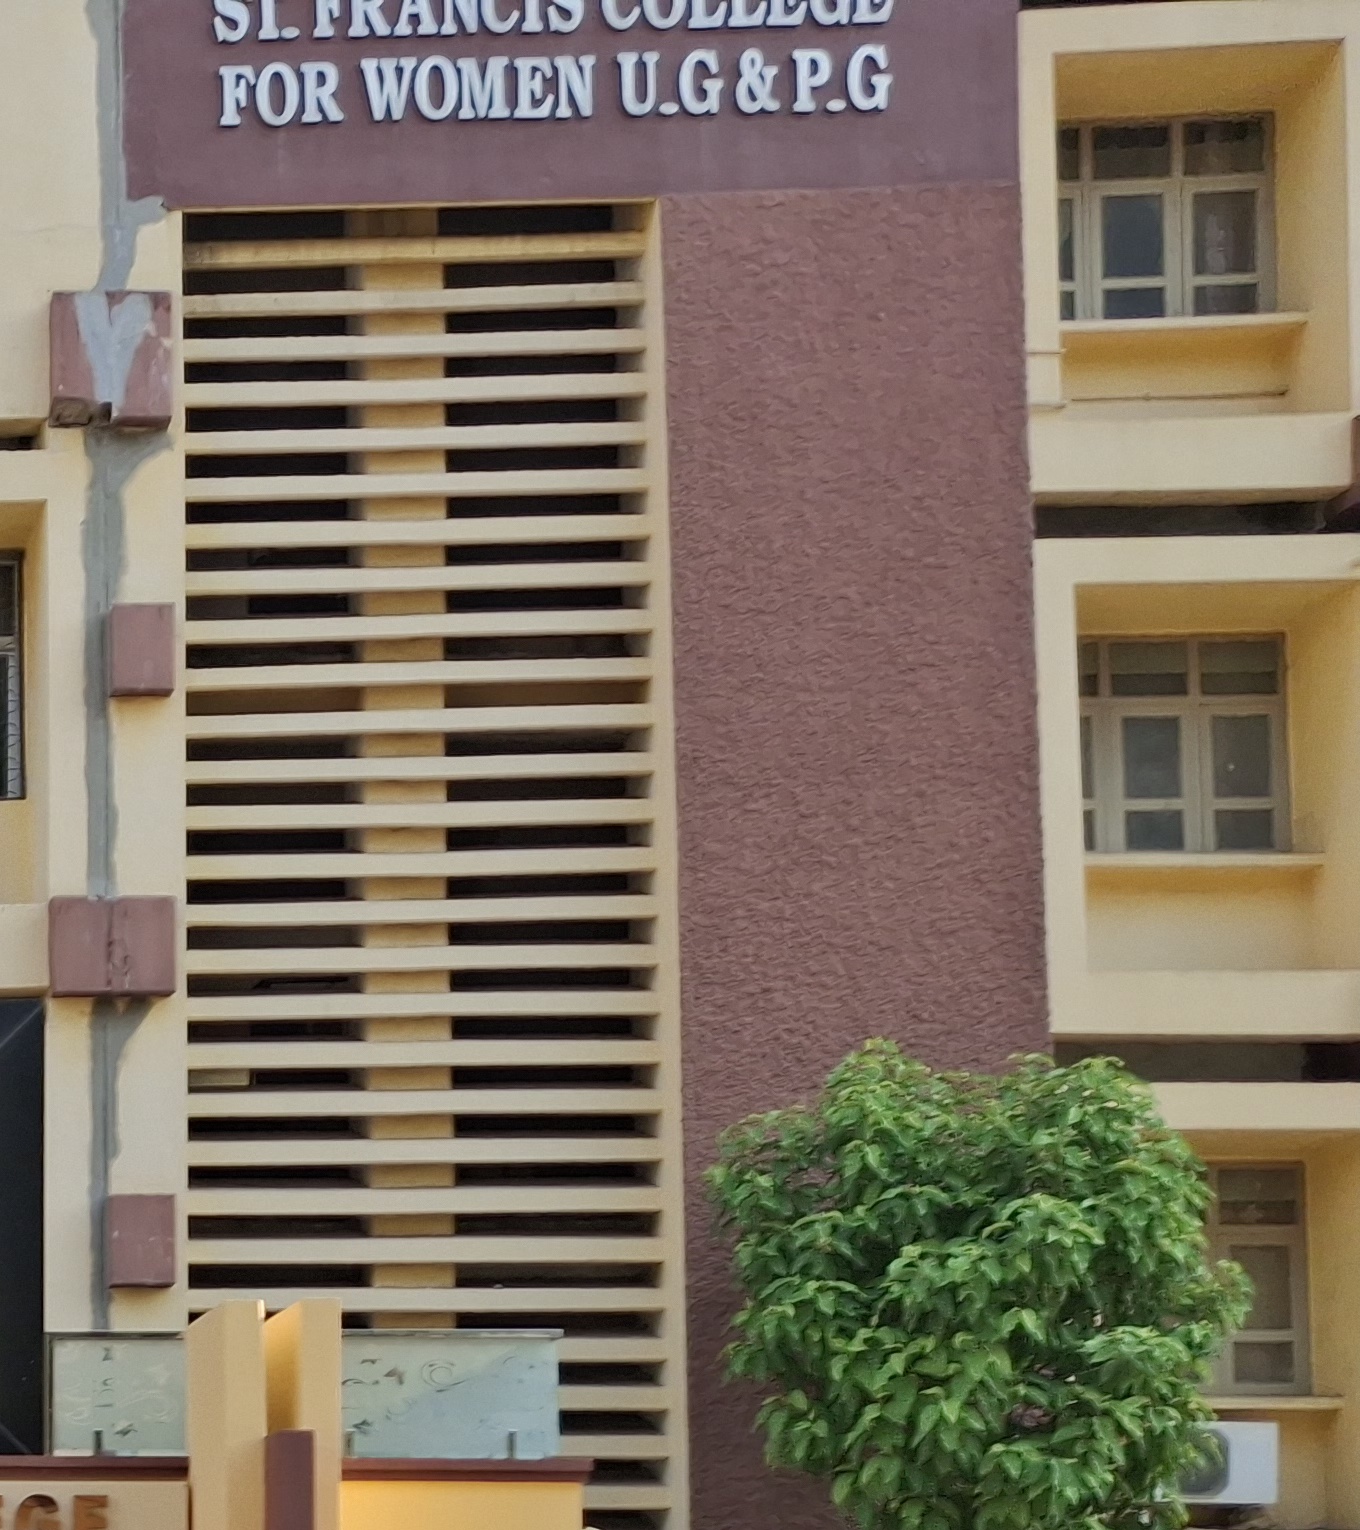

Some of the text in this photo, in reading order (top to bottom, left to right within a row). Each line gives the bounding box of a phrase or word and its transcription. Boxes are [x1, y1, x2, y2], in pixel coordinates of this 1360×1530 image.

[218, 43, 894, 127] FOR WOMEN U.G & P.G
